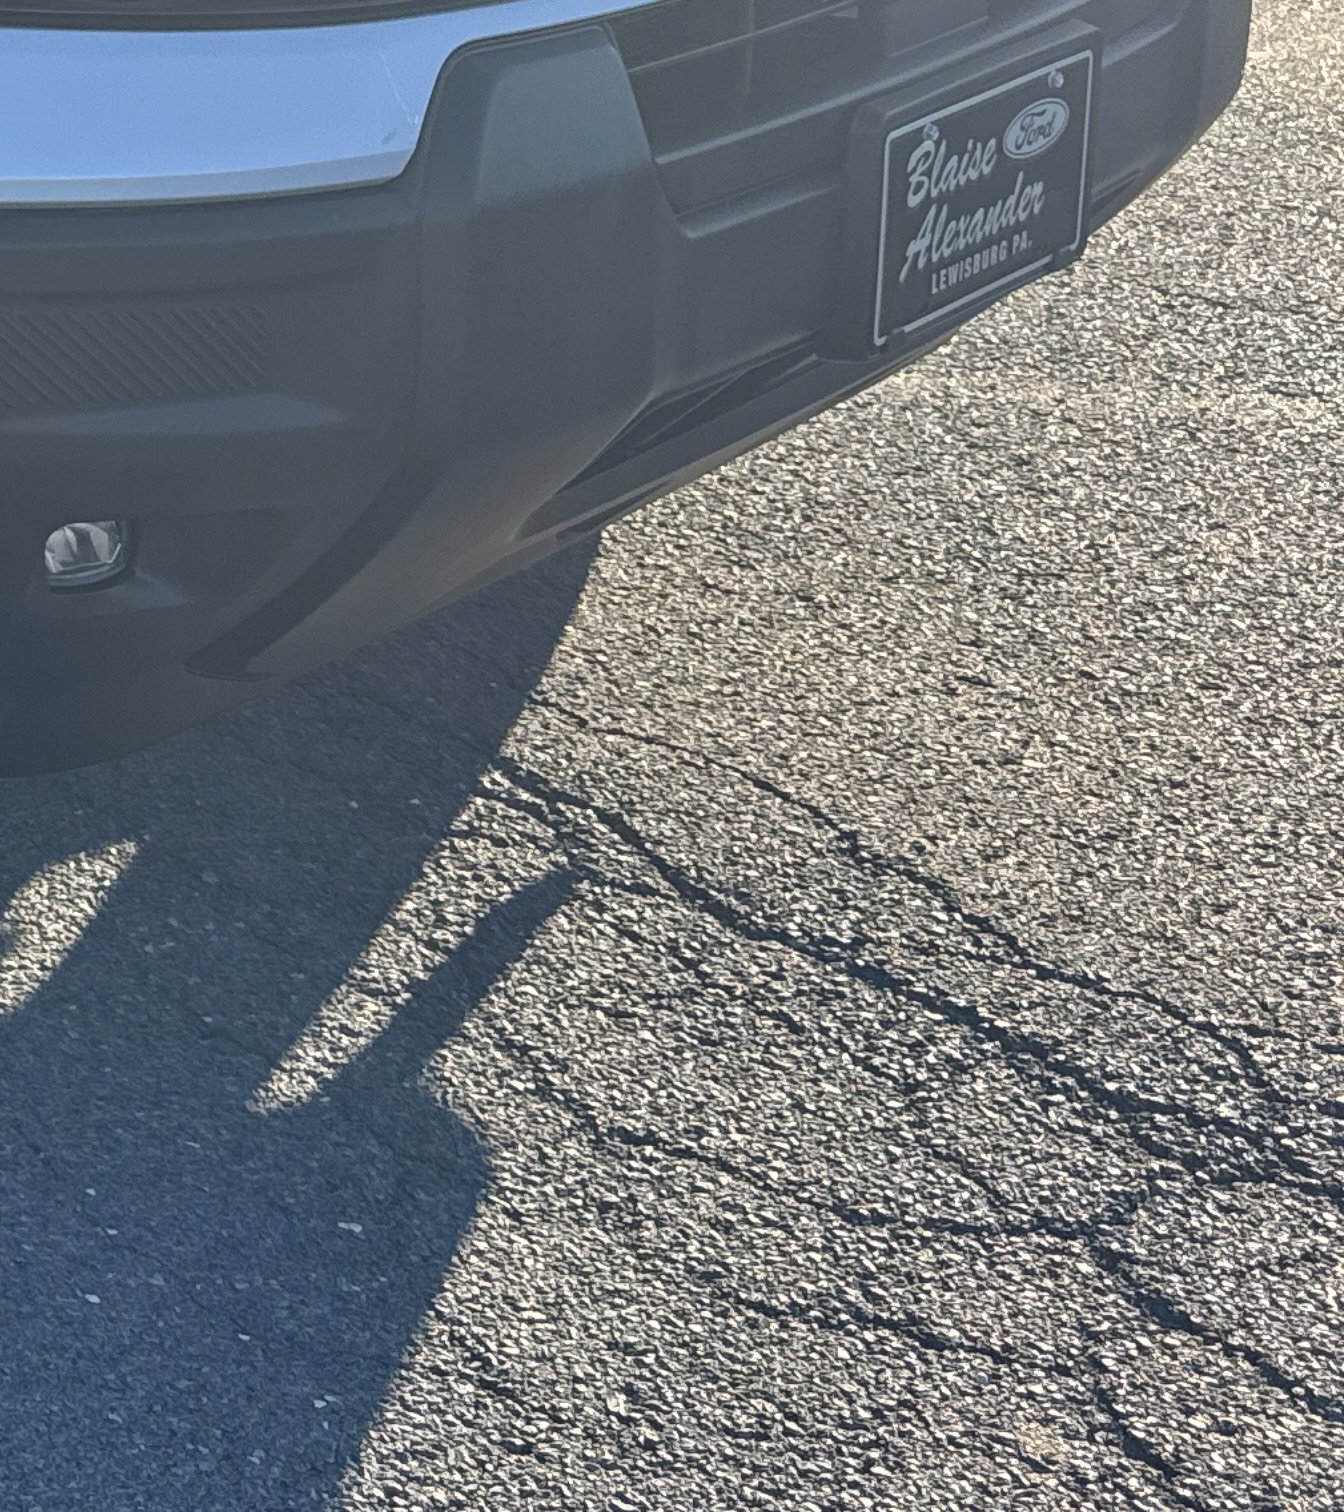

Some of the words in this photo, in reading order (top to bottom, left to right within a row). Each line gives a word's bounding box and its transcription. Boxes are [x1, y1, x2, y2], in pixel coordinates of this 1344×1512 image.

[907, 138, 997, 208] Blaise
[1014, 108, 1058, 151] Ford
[899, 171, 1045, 283] Alexander
[931, 240, 1007, 295] LEWISBURG
